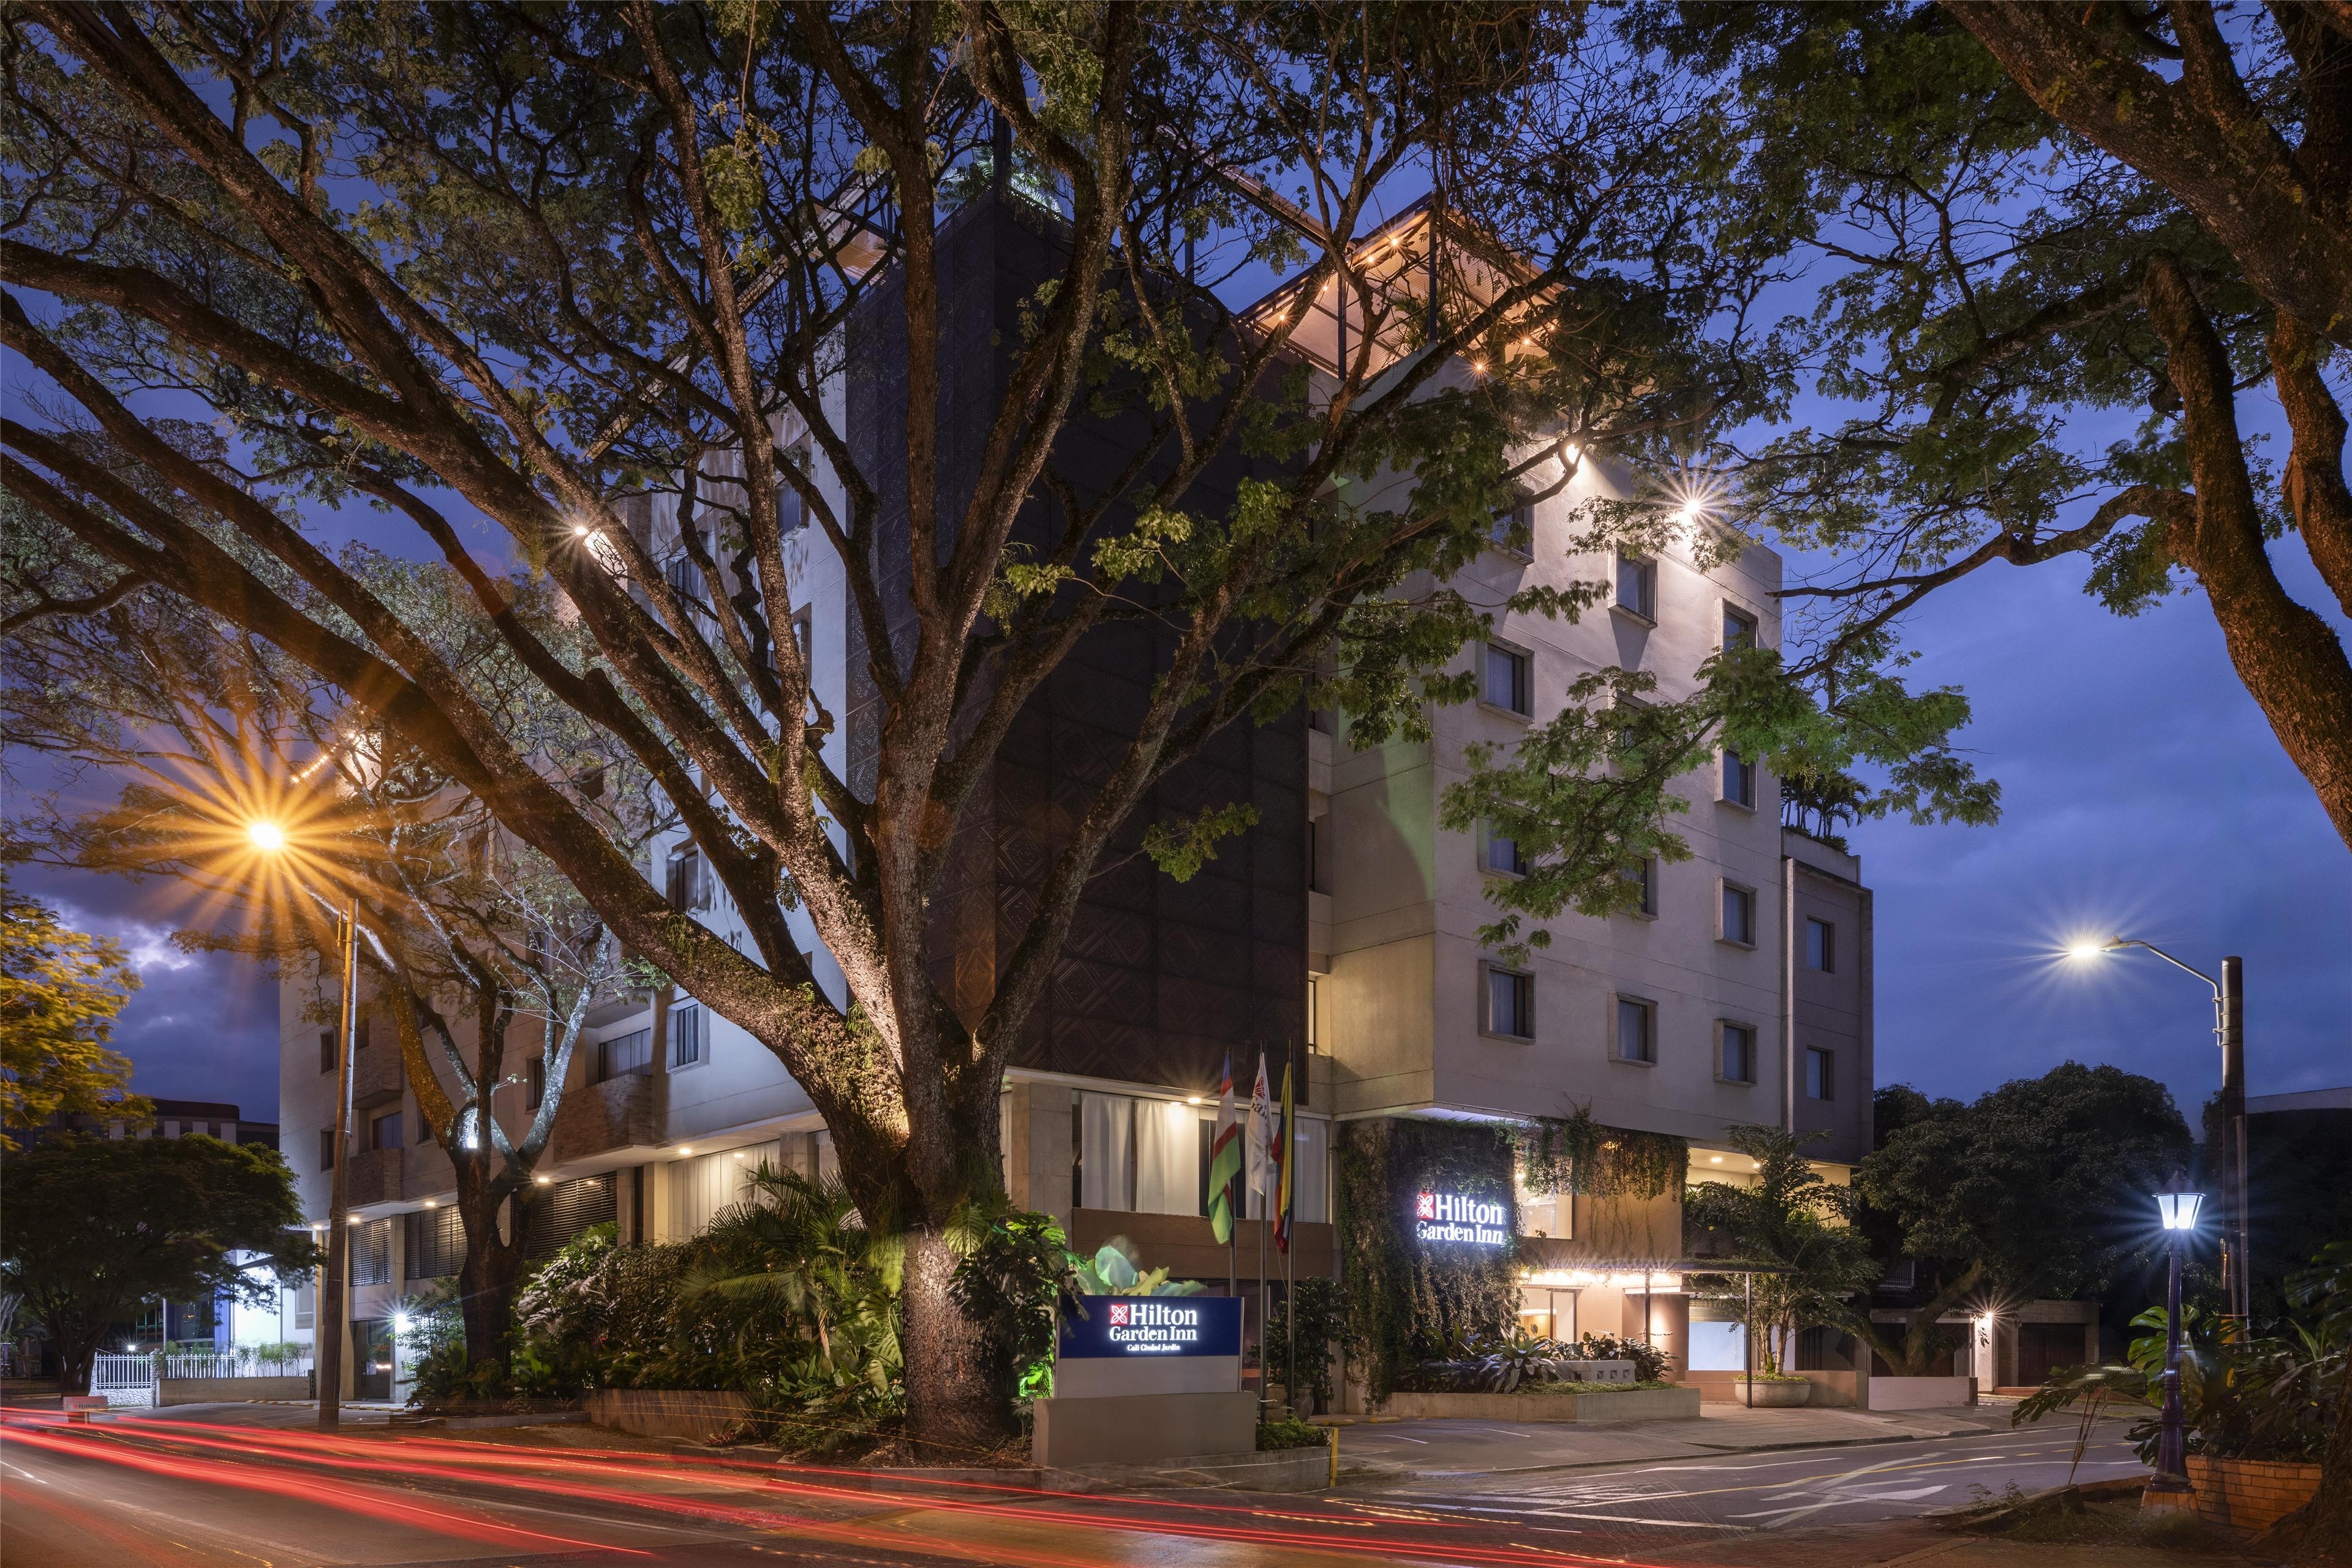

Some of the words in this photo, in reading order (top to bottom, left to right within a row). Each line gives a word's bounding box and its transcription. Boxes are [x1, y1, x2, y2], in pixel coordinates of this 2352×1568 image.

[1435, 1194, 1503, 1225] Hilton
[1416, 1220, 1474, 1242] Garden
[1476, 1224, 1504, 1245] Inn
[1129, 1304, 1197, 1325] Hilton
[1109, 1325, 1168, 1341] Garden
[1169, 1325, 1197, 1341] Inn
